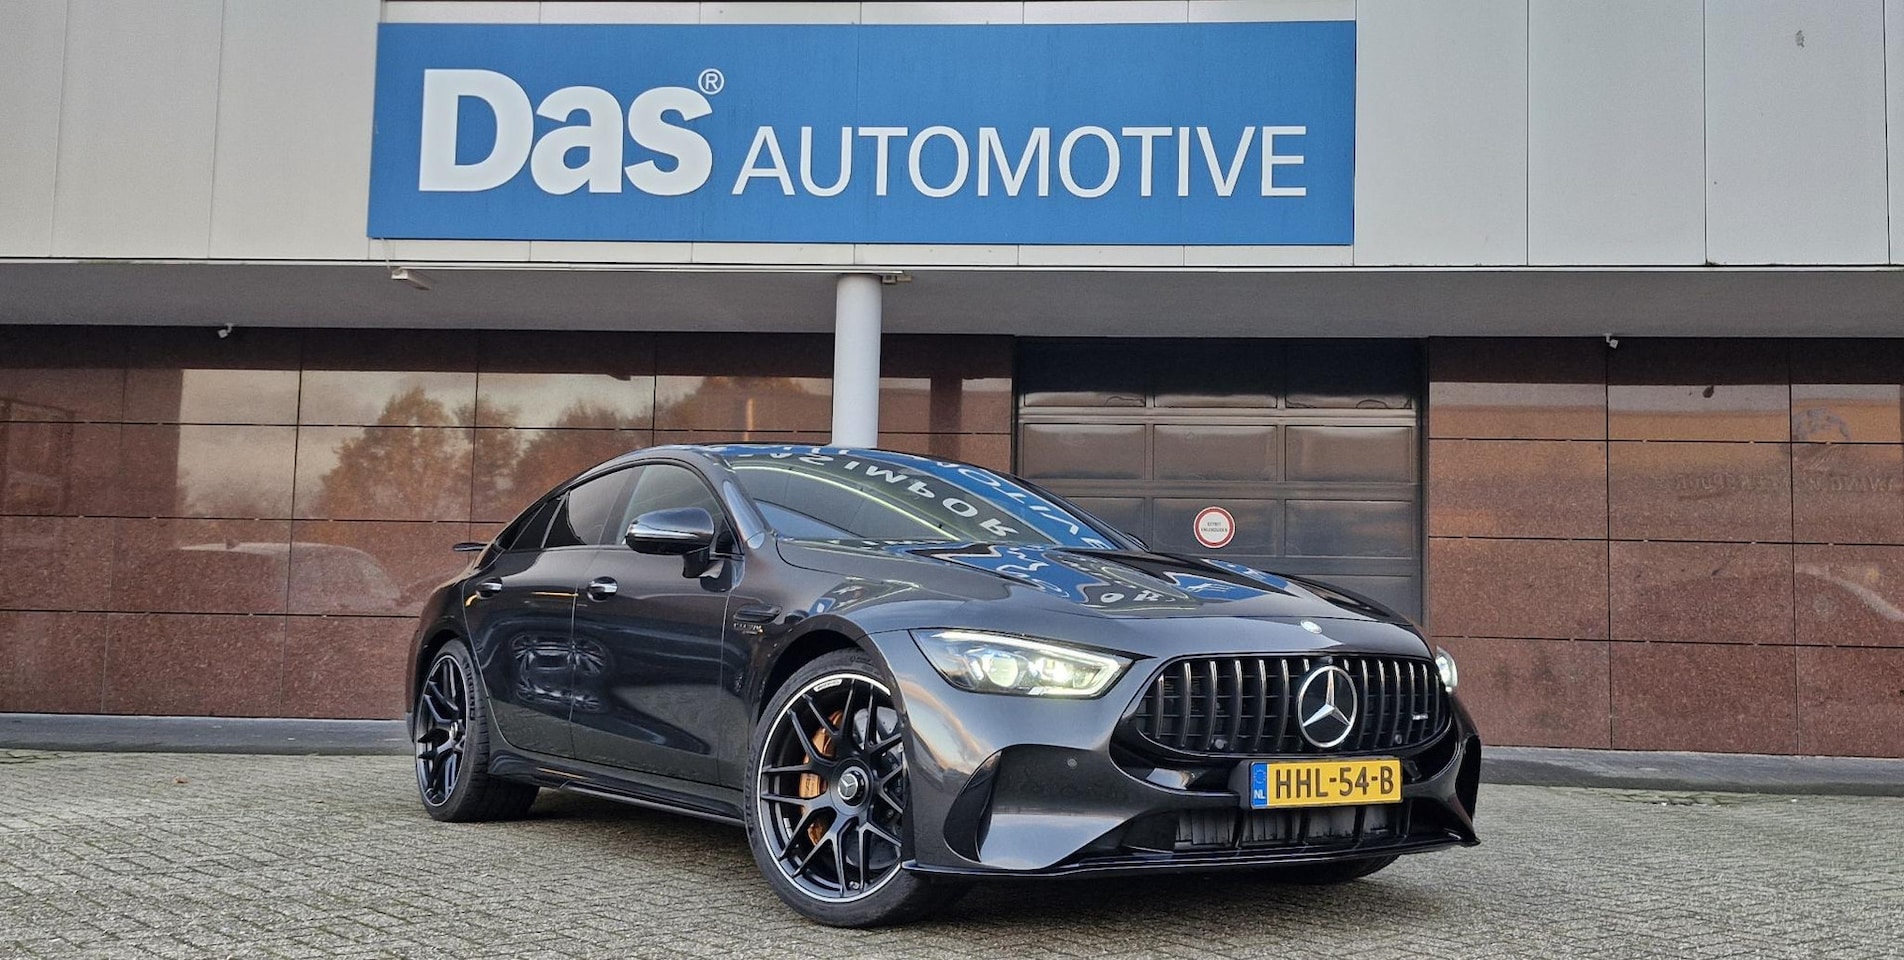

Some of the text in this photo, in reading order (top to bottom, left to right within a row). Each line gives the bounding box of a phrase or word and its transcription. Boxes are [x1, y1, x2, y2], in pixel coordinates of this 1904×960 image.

[732, 126, 1307, 198] AUTOMOTIVE
[1254, 766, 1394, 799] NL HHL-54-B
